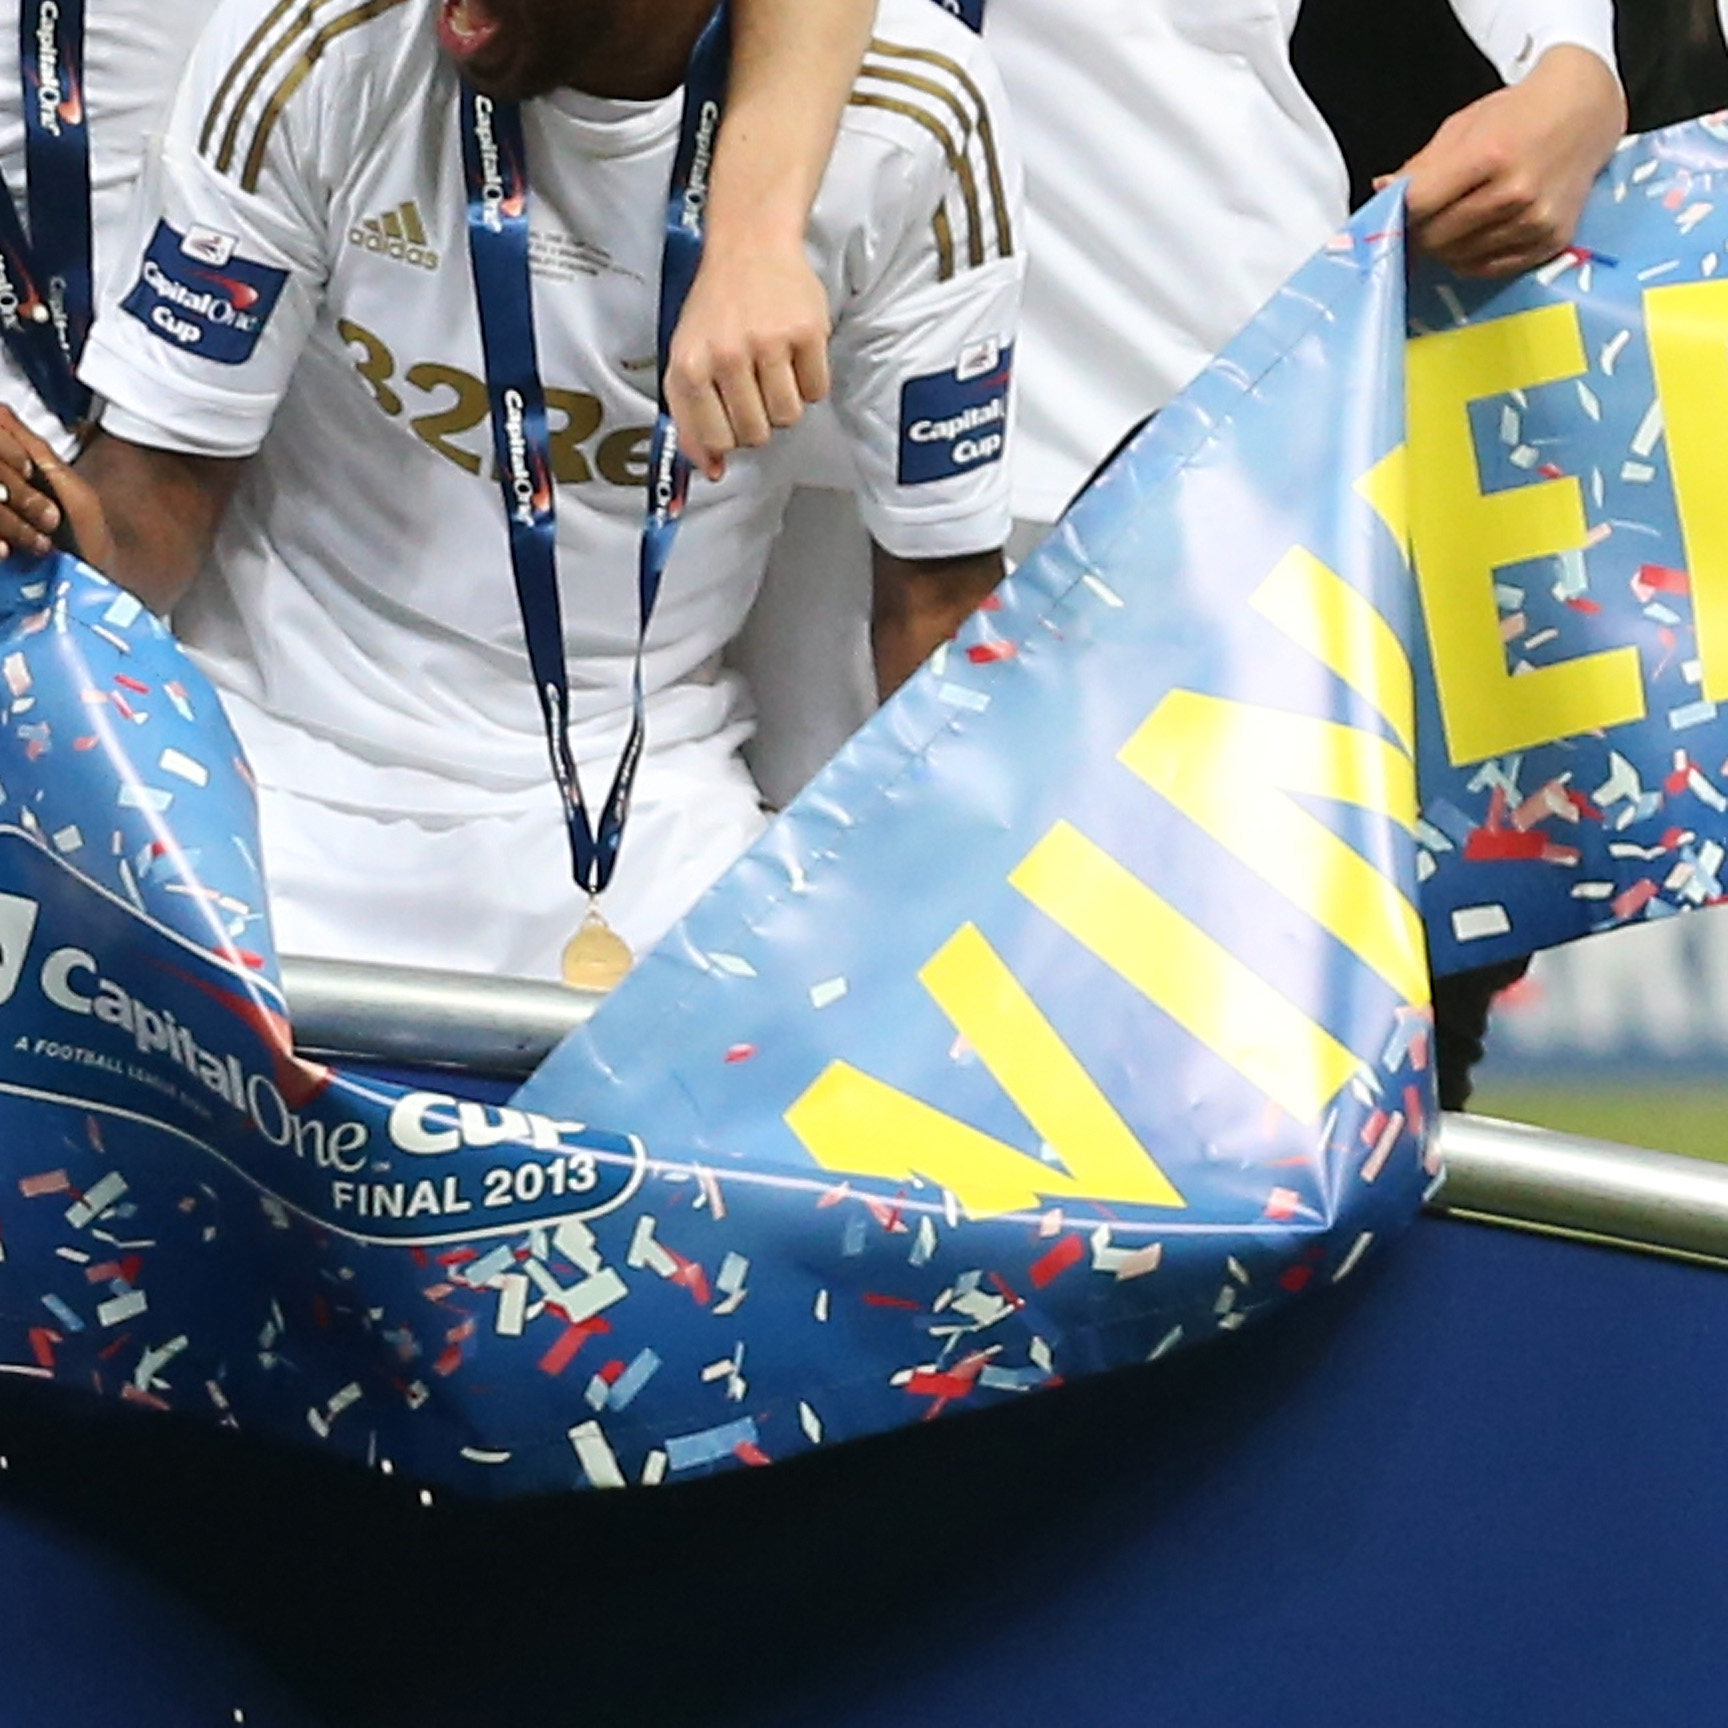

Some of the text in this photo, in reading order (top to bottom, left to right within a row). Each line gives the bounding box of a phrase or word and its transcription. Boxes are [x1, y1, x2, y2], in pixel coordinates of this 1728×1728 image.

[349, 227, 439, 271] adidas
[152, 305, 202, 343] Cup
[909, 398, 1004, 442] Capital
[952, 434, 1002, 463] Cup
[13, 1036, 29, 1051] A
[34, 1038, 123, 1074] FOOTBALL
[41, 947, 368, 1173] CapitalOne
[333, 1155, 598, 1219] FINAL 2013
